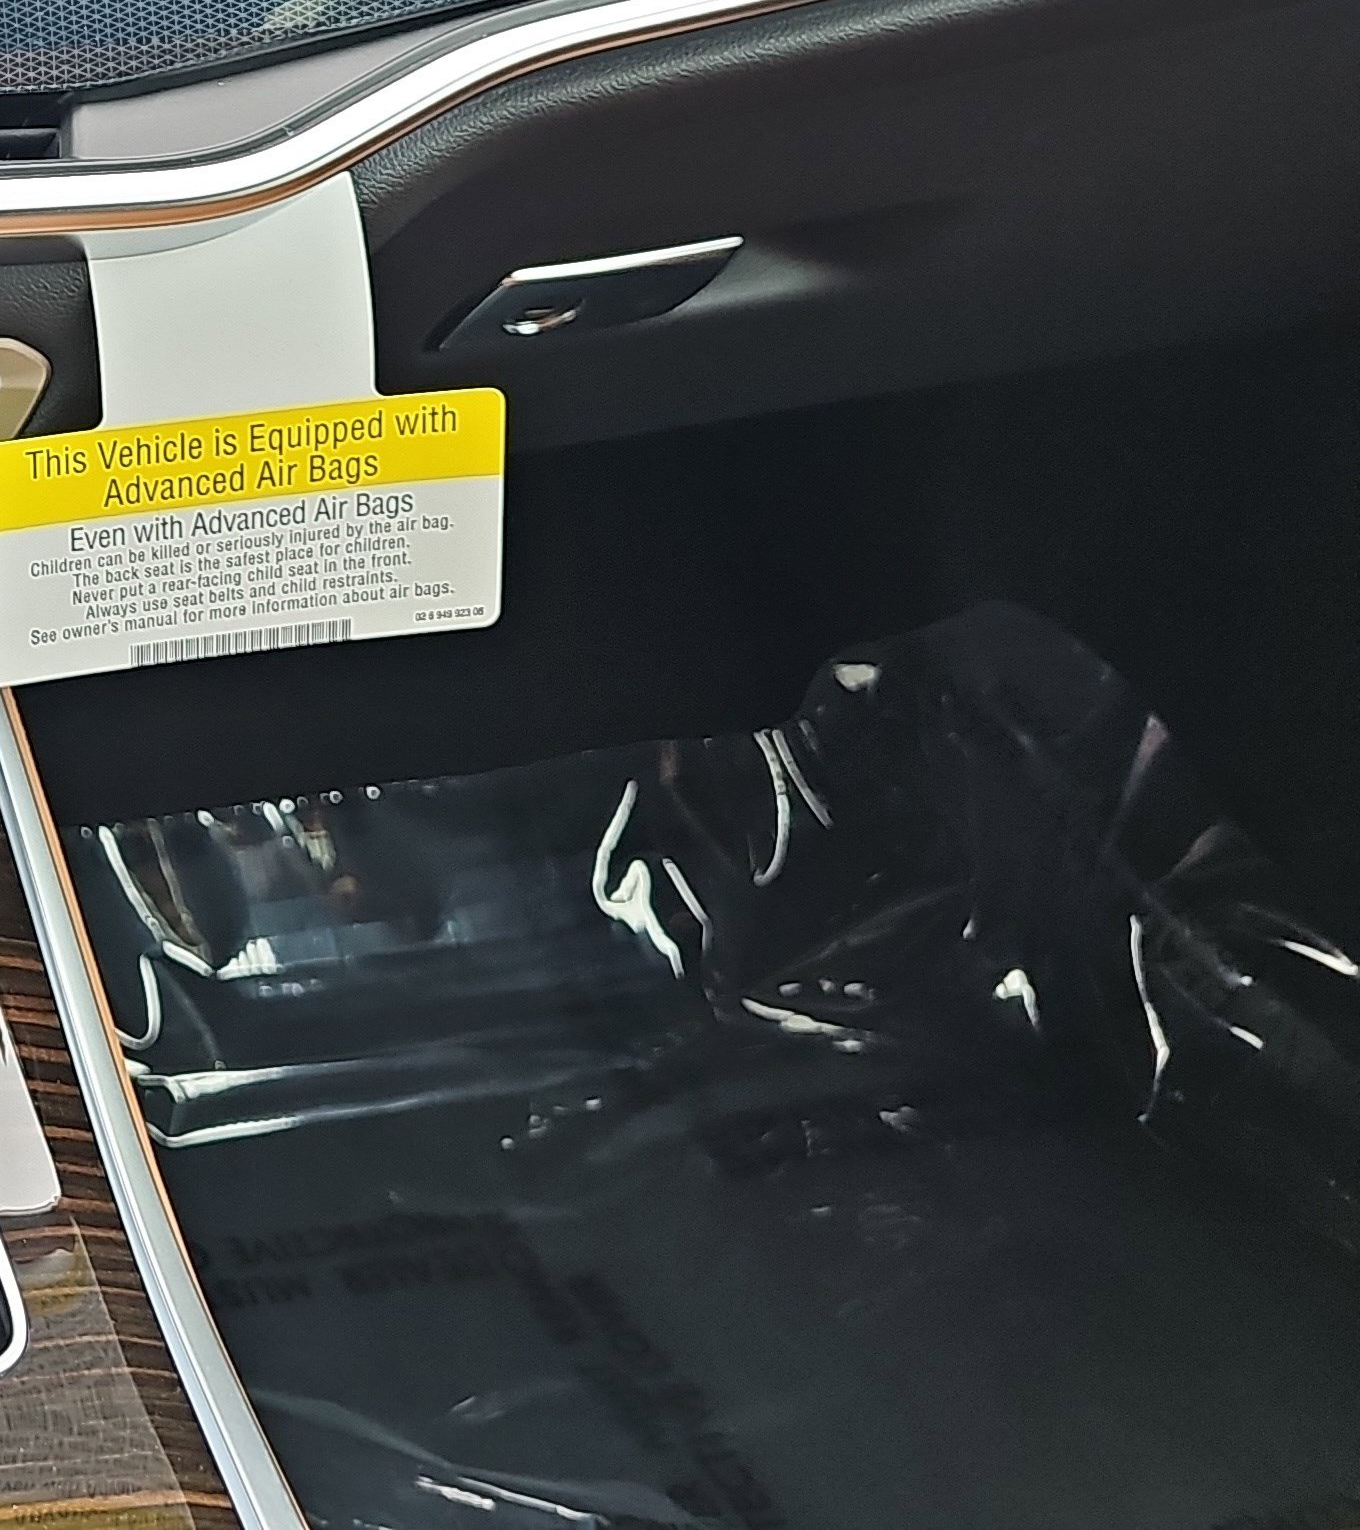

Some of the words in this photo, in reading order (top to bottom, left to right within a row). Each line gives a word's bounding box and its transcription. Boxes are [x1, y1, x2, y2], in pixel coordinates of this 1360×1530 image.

[25, 446, 87, 480] This
[97, 432, 203, 470] Vehicle
[214, 427, 237, 457] is
[249, 409, 383, 456] Equipped
[394, 404, 457, 436] with
[103, 462, 245, 508] Advanced
[256, 458, 298, 490] Air
[309, 454, 378, 485] Bags
[30, 557, 92, 577] Children
[97, 553, 123, 568] can
[128, 549, 145, 564] be
[151, 541, 190, 561] killed
[196, 542, 212, 556] or
[216, 531, 284, 553] seriously
[289, 524, 340, 546] injured
[346, 522, 364, 538] by
[369, 520, 392, 535] the
[397, 516, 418, 532] air
[422, 515, 454, 531] bag.
[70, 526, 126, 552] Even
[133, 515, 183, 544] with
[190, 499, 306, 537] Advanced
[313, 495, 349, 522] Air
[356, 492, 414, 520] Bags
[72, 572, 100, 588] The
[105, 565, 140, 584] back
[144, 561, 175, 579] seat
[180, 559, 193, 574] is
[198, 556, 221, 572] the
[226, 549, 271, 568] safest
[275, 546, 314, 565] place
[319, 542, 341, 557] for
[345, 536, 410, 554] children.
[72, 588, 115, 605] Never
[119, 582, 144, 602] put
[148, 583, 156, 595] a
[162, 571, 242, 593] rear-facing
[247, 564, 283, 582] child
[288, 561, 319, 578] seat
[324, 558, 337, 573] in
[343, 556, 365, 571] the
[371, 551, 412, 568] front.
[30, 629, 57, 646] See
[62, 619, 119, 640] owner's
[124, 610, 178, 632] manual
[183, 608, 205, 624] for
[209, 604, 247, 620] more
[252, 592, 337, 615] information
[342, 587, 385, 604] about
[389, 584, 410, 599] air
[414, 582, 455, 598] bags.
[85, 602, 137, 620] Always
[142, 598, 168, 612] use
[173, 591, 204, 609] seat
[209, 587, 245, 604] belts
[249, 581, 276, 599] and
[281, 576, 317, 595] child
[322, 570, 398, 590] restraints.
